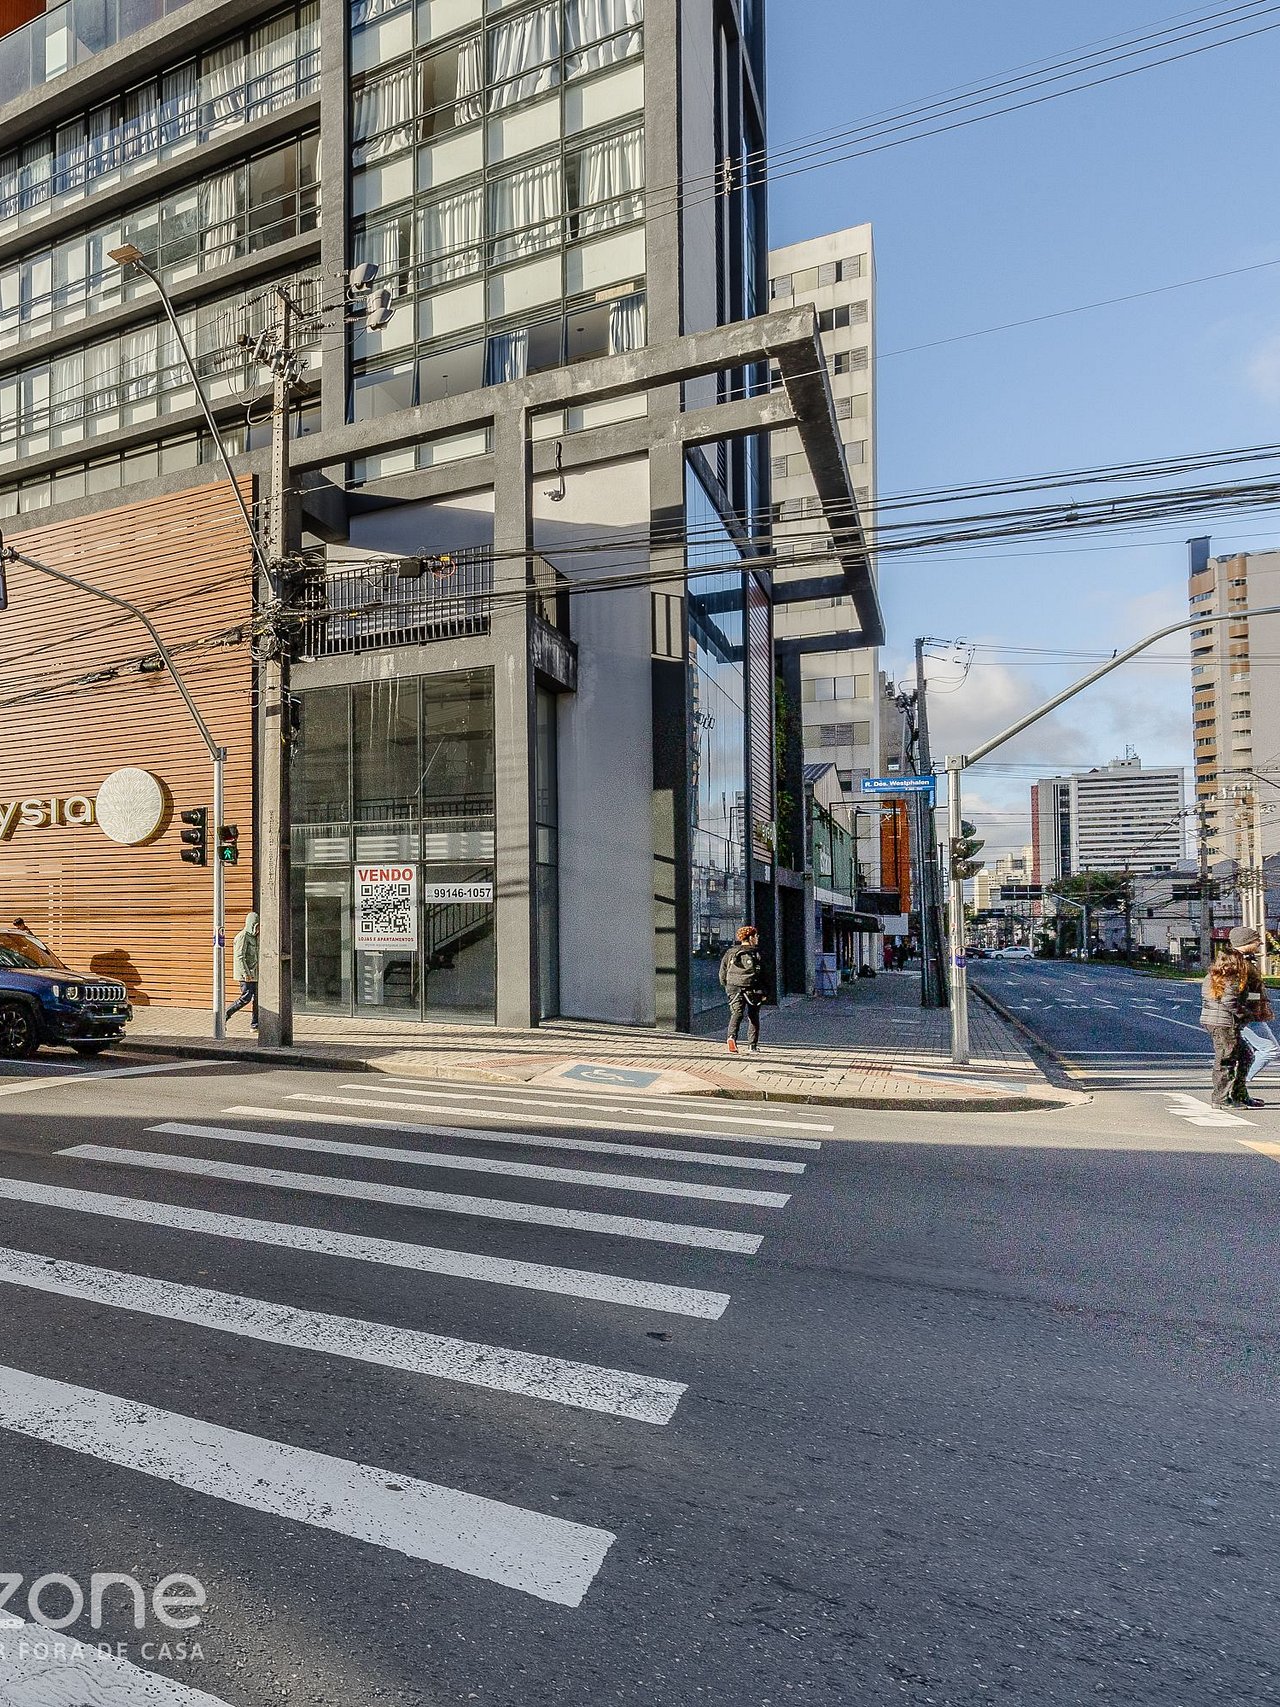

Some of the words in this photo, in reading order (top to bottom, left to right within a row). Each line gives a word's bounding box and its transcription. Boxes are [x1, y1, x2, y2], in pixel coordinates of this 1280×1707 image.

[889, 779, 930, 787] Westphalen
[358, 868, 414, 882] VENDO
[433, 888, 492, 898] 99146-1057
